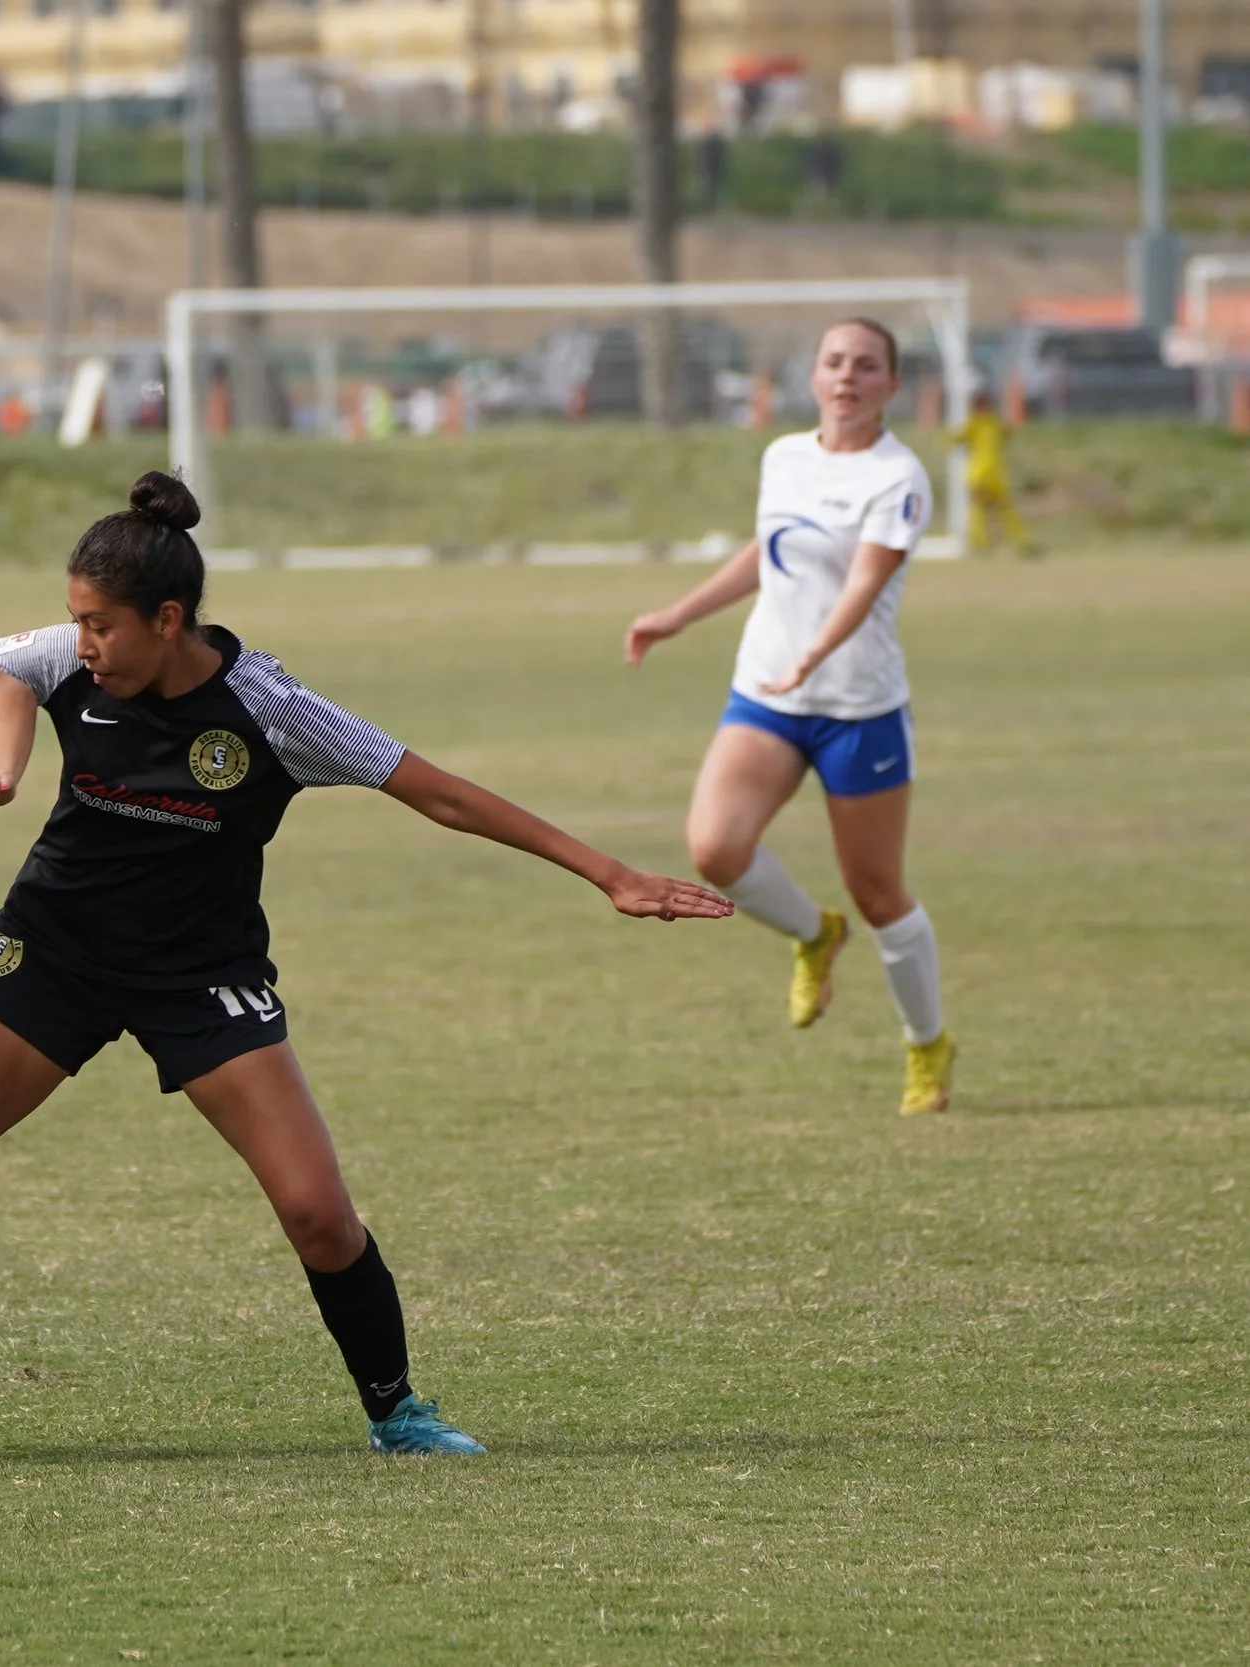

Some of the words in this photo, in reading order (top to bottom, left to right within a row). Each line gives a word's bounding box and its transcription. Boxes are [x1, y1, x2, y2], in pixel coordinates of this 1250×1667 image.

[197, 731, 225, 746] SOCAL
[225, 734, 247, 754] ELITE
[191, 759, 225, 789] FOOTBALL
[225, 767, 246, 787] CLUB
[70, 783, 222, 833] TRANSMISSION
